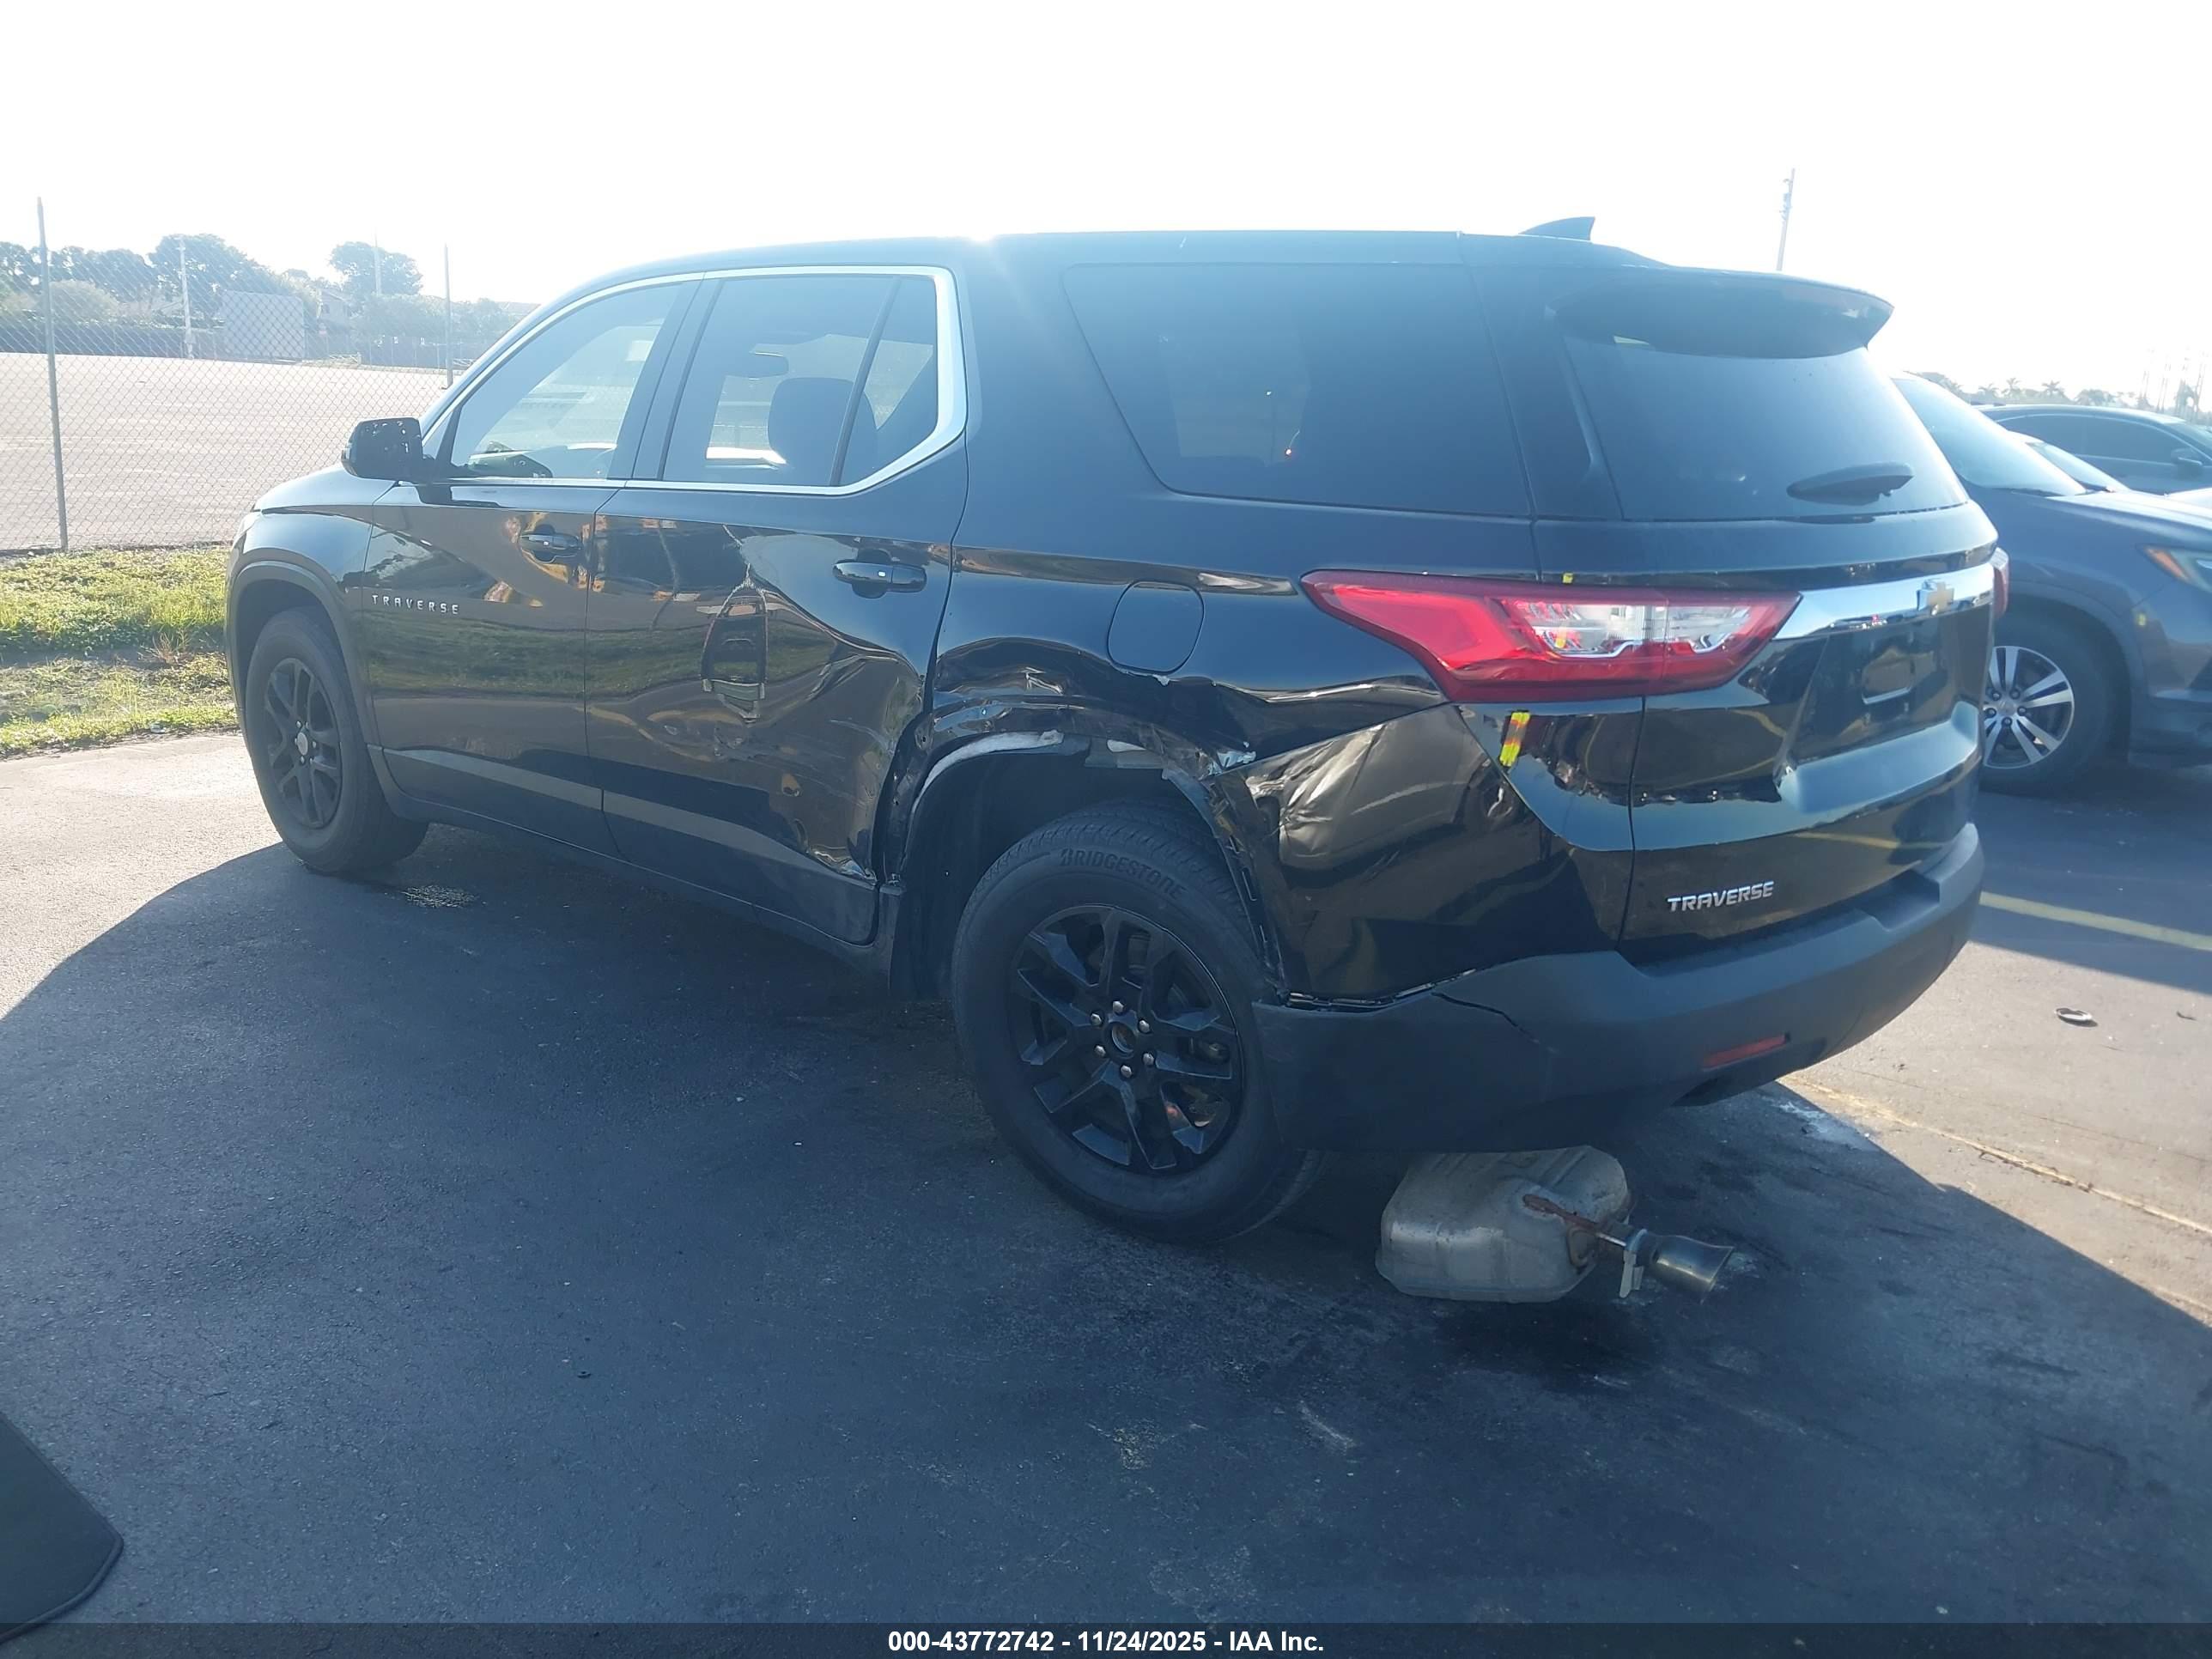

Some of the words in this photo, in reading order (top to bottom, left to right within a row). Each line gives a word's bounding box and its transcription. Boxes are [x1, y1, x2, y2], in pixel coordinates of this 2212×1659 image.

[371, 594, 459, 615] TRAVERSE
[1059, 848, 1188, 900] BRIDGESTONE
[1667, 880, 1775, 912] TRAVERSE
